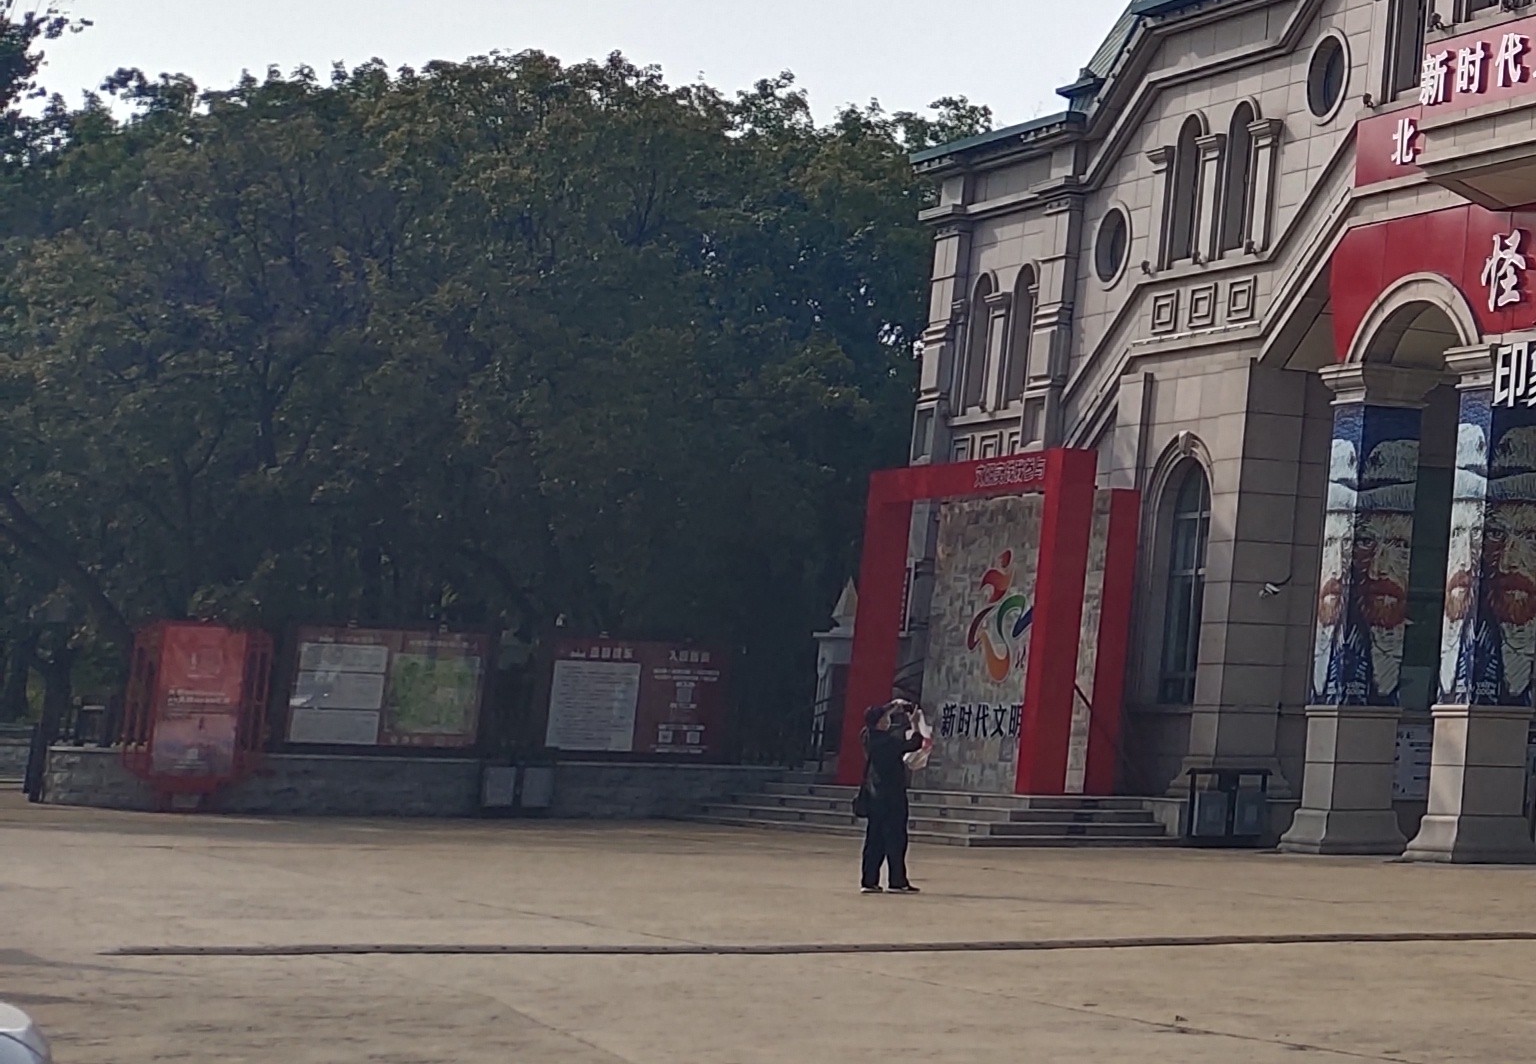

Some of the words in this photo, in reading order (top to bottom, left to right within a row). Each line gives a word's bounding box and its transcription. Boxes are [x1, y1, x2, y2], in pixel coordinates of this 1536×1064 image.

[1391, 117, 1415, 165] 北
[941, 702, 1023, 738] 新时代文明
